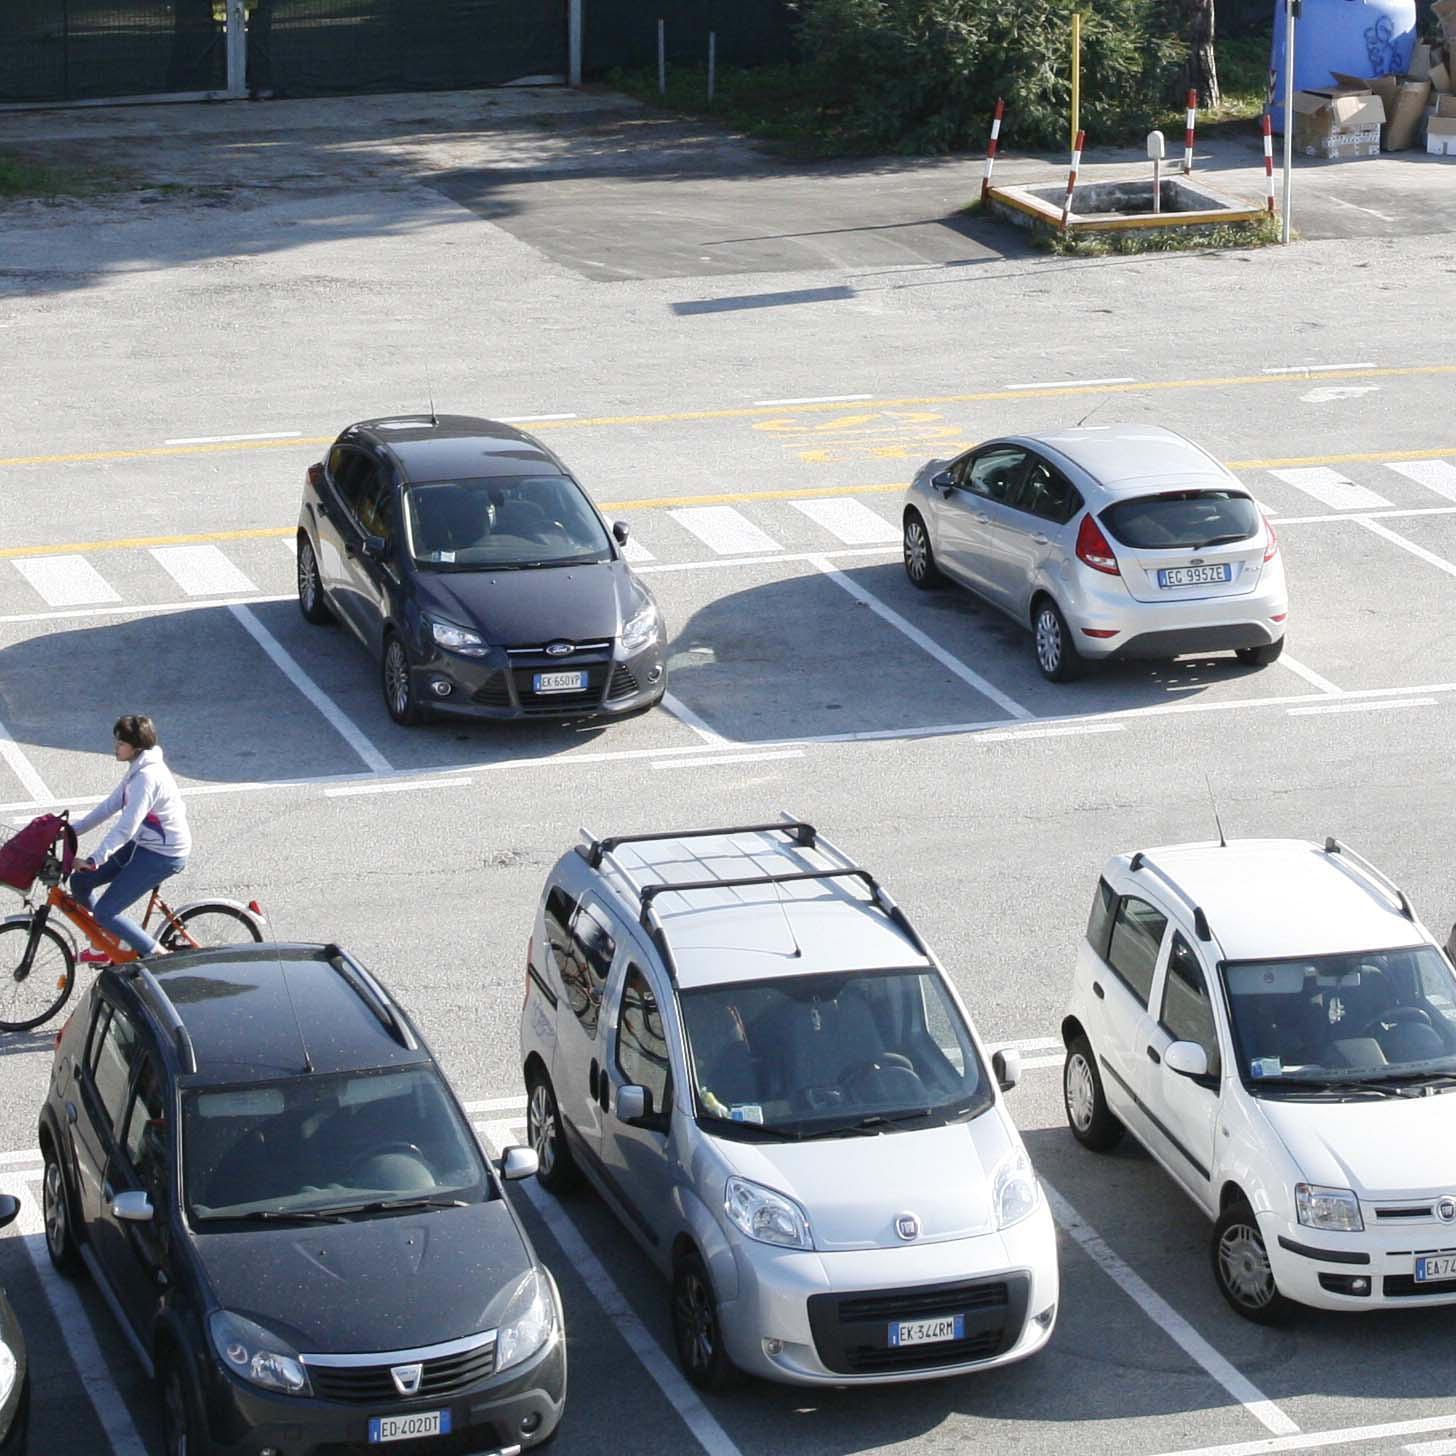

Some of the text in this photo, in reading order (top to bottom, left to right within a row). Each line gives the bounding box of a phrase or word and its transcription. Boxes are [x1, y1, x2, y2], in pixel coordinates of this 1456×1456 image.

[1186, 566, 1224, 582] 995ZE
[1426, 1261, 1440, 1276] EA
[900, 1321, 953, 1342] EK 344RM
[382, 1416, 439, 1437] ED 402DT
